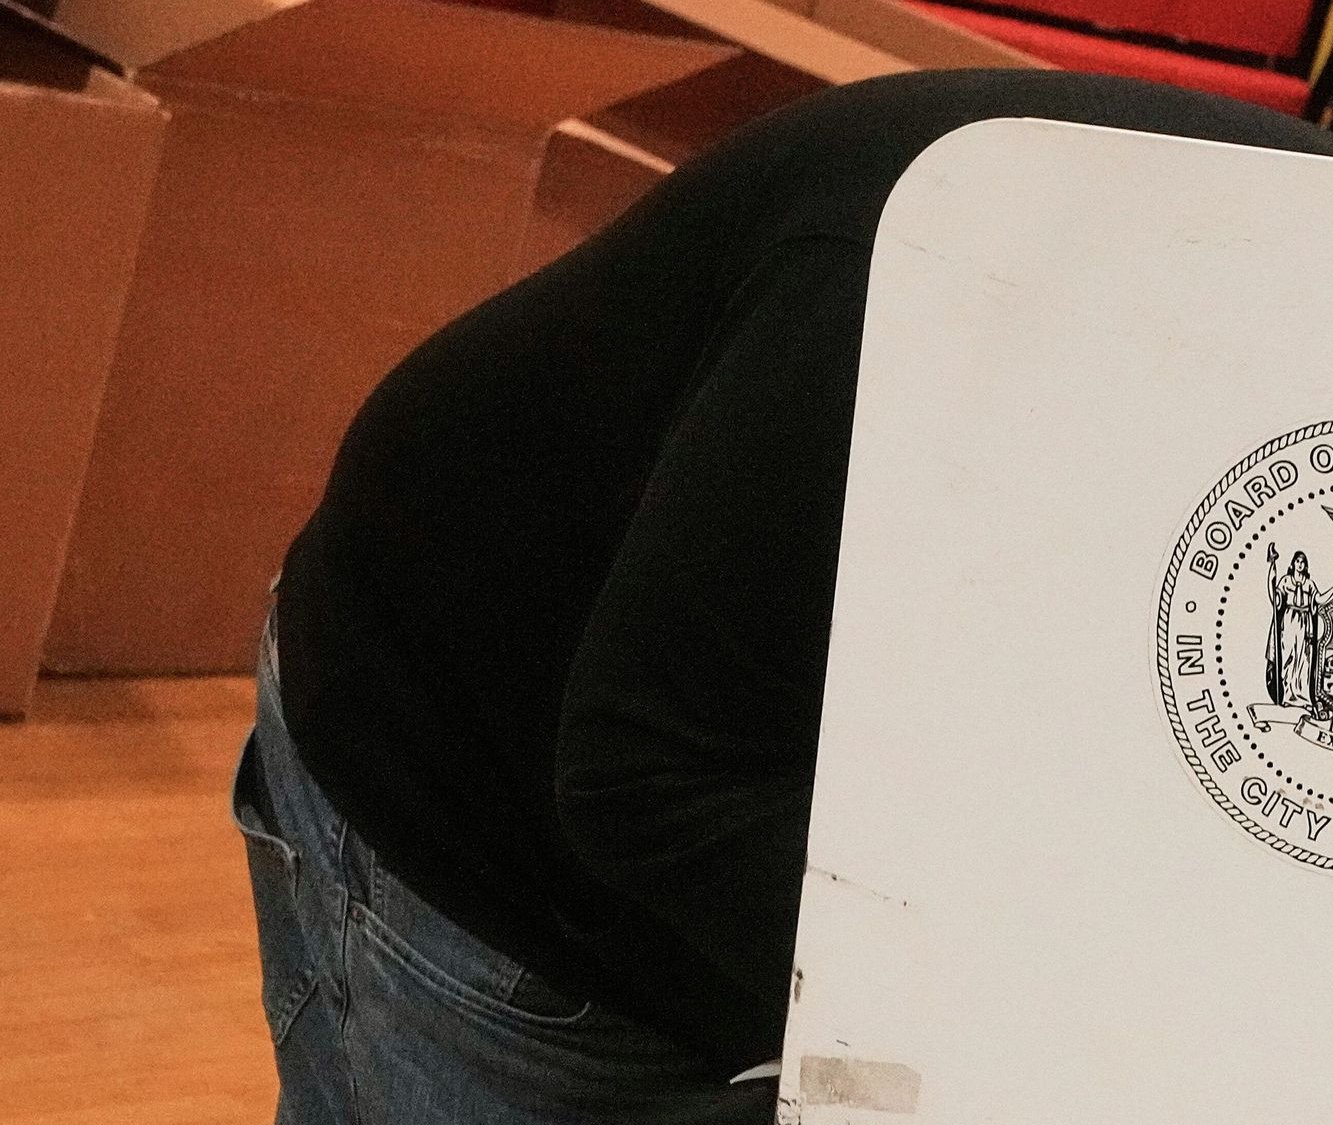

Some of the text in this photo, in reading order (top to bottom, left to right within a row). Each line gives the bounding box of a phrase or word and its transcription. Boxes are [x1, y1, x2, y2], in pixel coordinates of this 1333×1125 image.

[1190, 460, 1299, 580] BOARD
[1177, 634, 1204, 677] IN
[1187, 689, 1242, 773] THE
[1240, 777, 1331, 841] CITY
